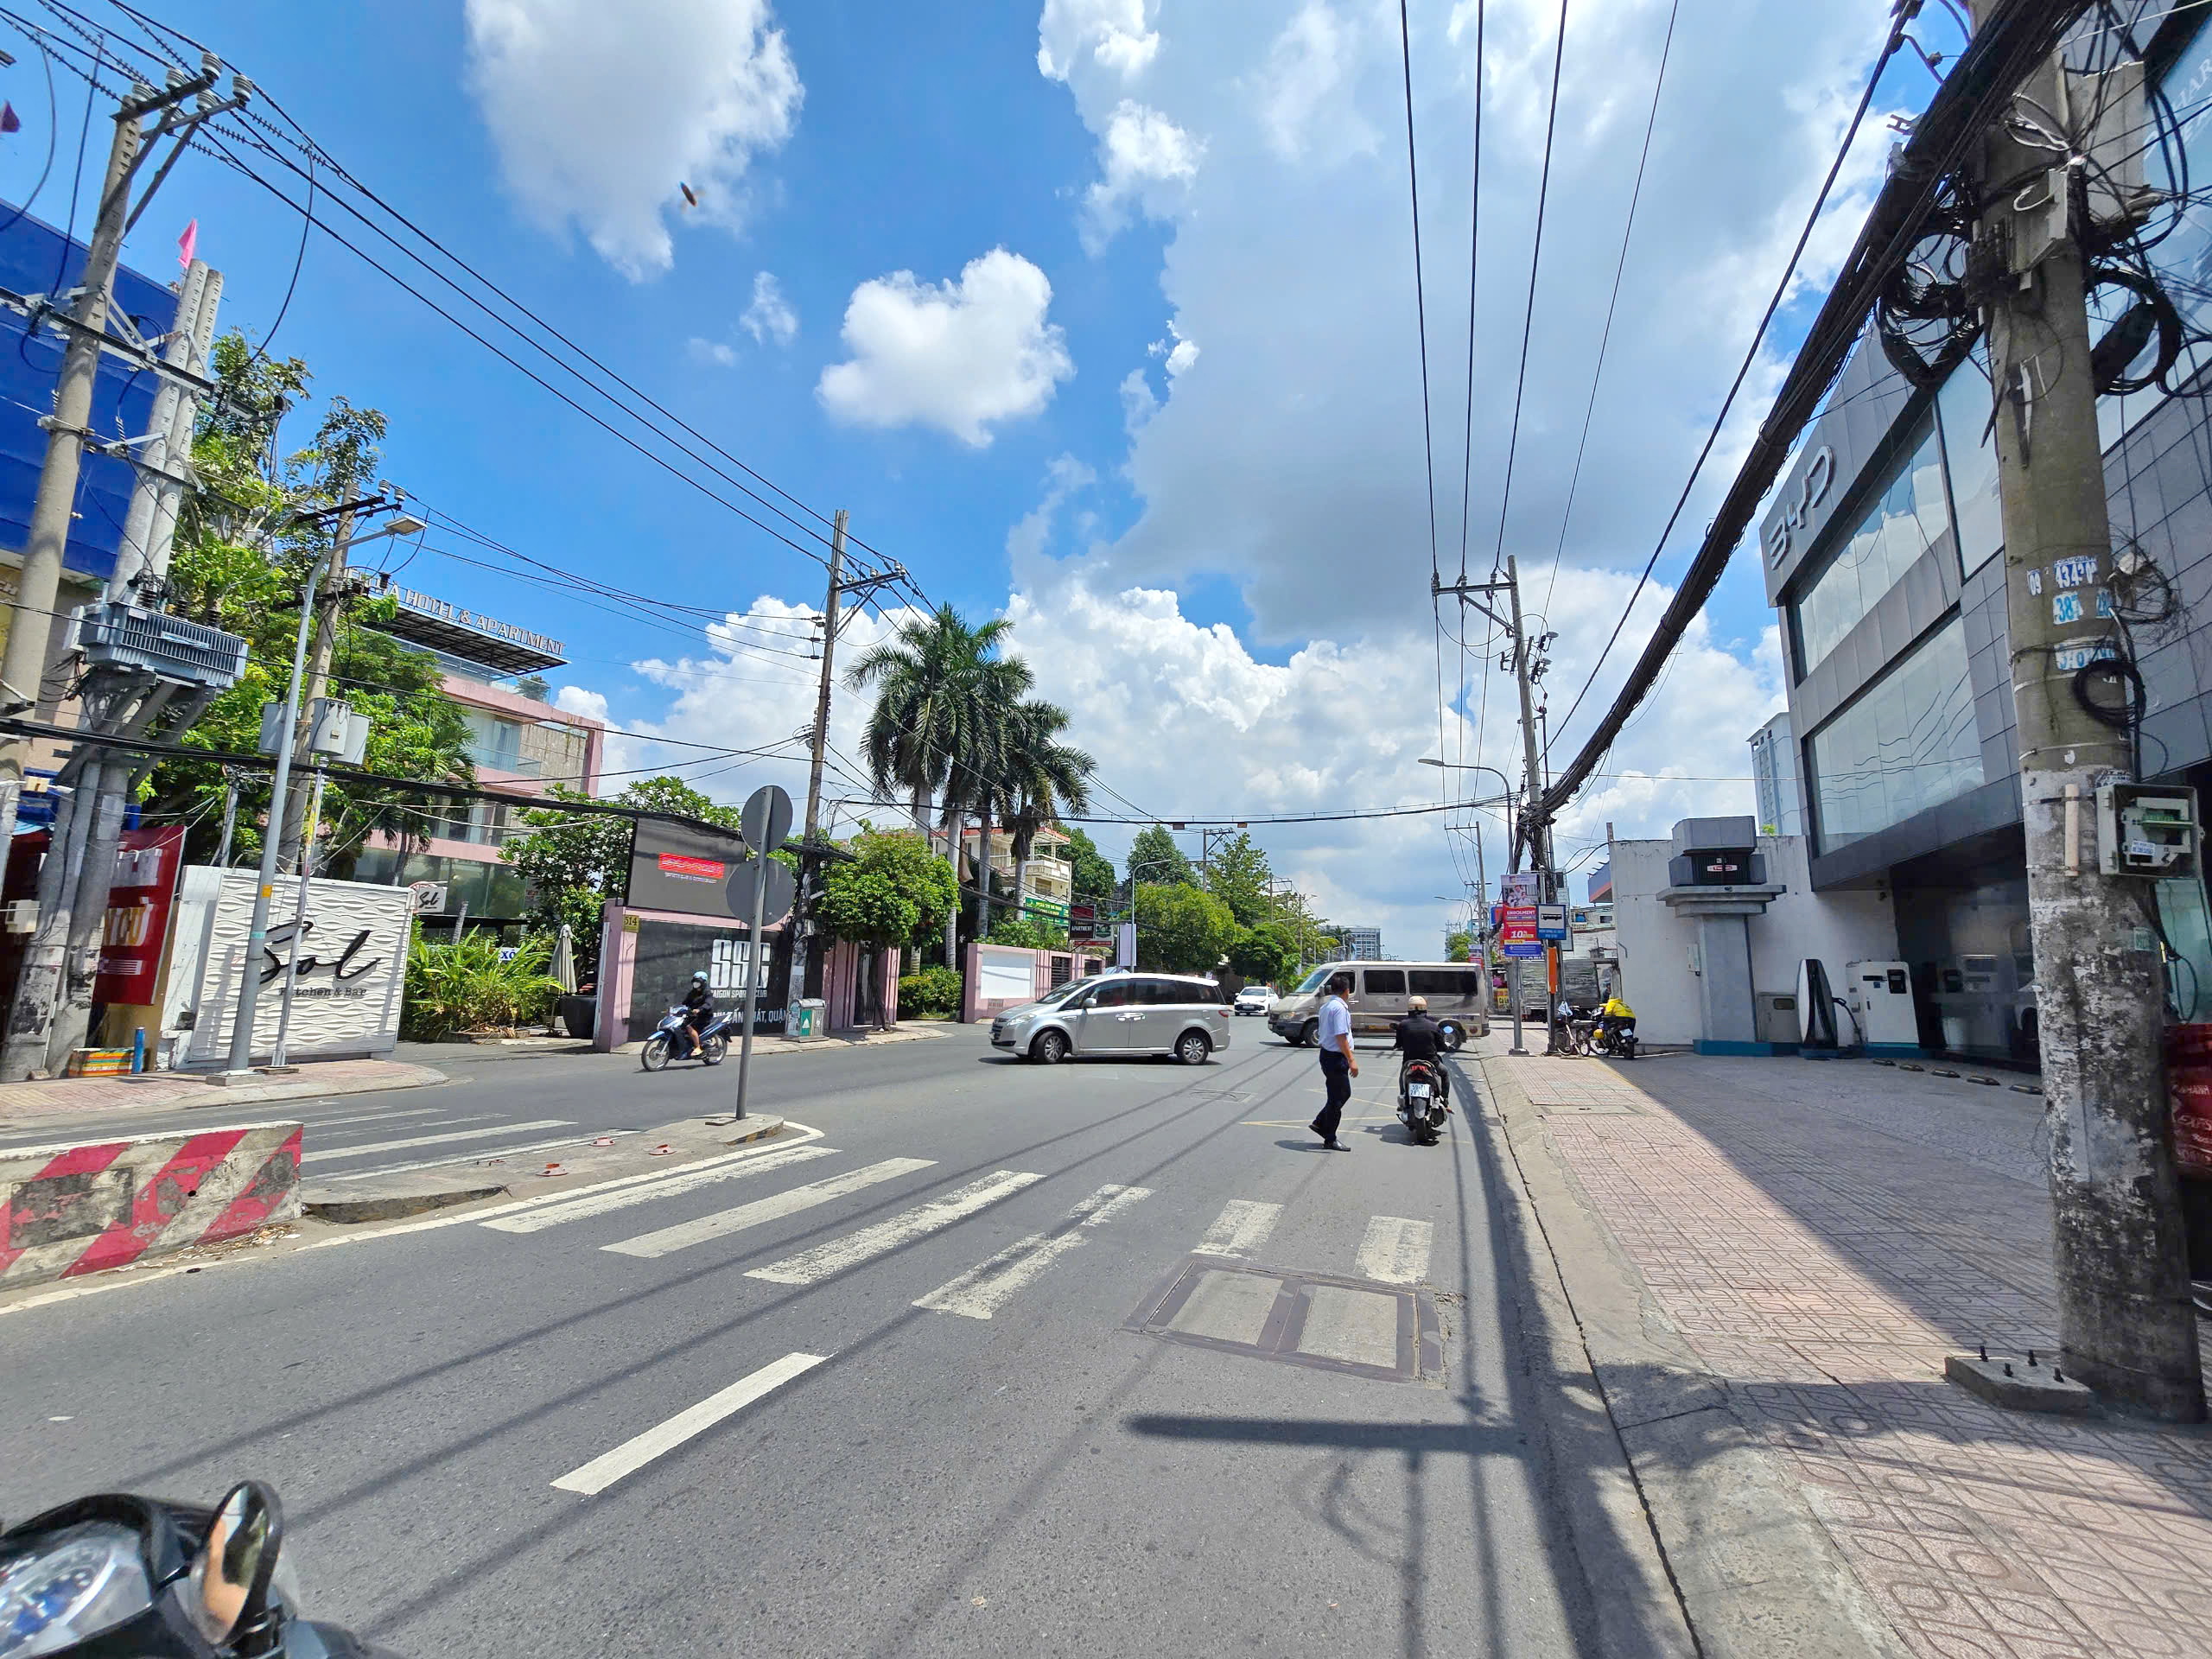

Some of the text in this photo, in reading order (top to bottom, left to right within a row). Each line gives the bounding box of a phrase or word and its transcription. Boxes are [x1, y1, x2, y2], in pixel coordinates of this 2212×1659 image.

[1769, 445, 1834, 570] BYD
[405, 588, 567, 656] HOTEL & APARTMENT
[278, 987, 366, 996] Ktchen & Bar
[710, 989, 730, 998] AIGON
